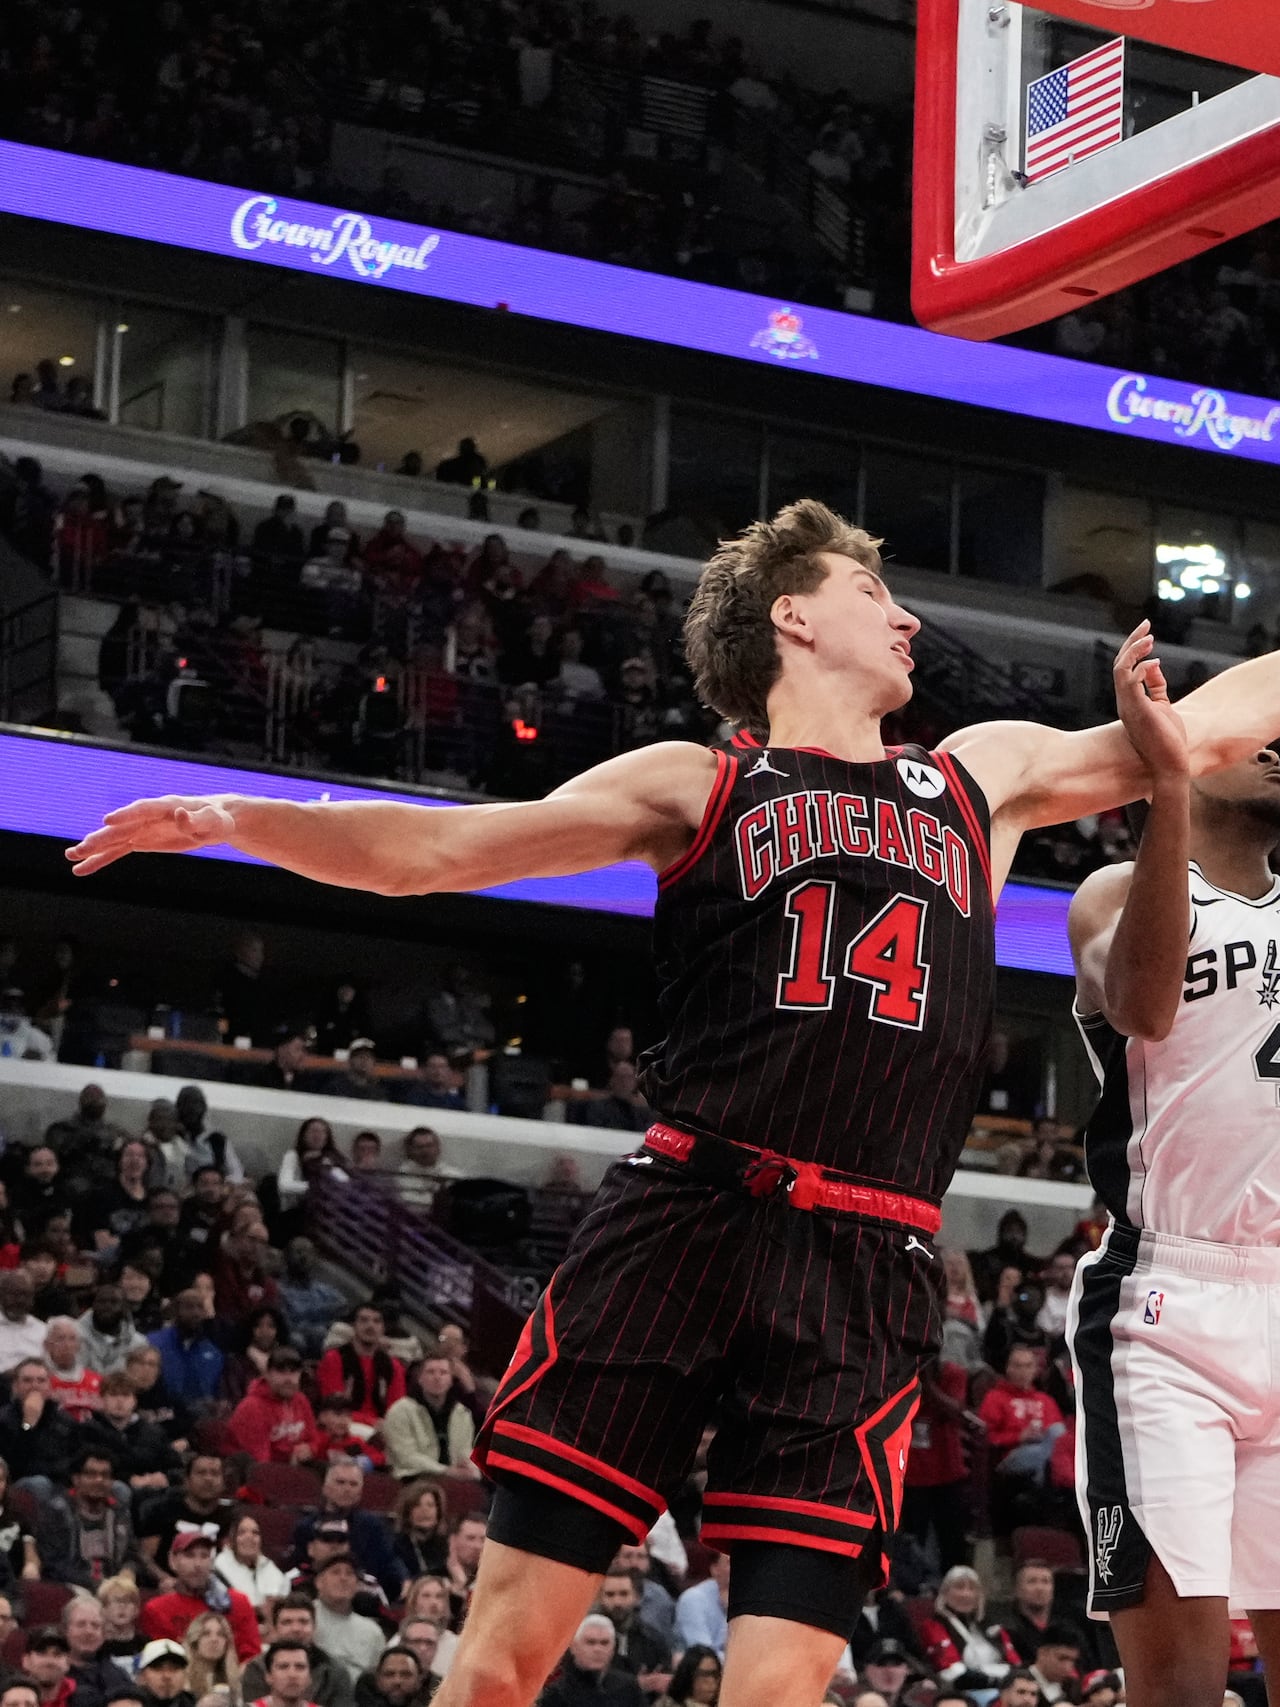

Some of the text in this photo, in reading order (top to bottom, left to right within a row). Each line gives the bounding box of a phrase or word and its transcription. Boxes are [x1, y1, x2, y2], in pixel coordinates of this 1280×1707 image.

[231, 195, 441, 279] Crown Royal
[1106, 374, 1195, 426] Crown
[734, 790, 971, 918] CHICAGO
[775, 878, 930, 1032] 14
